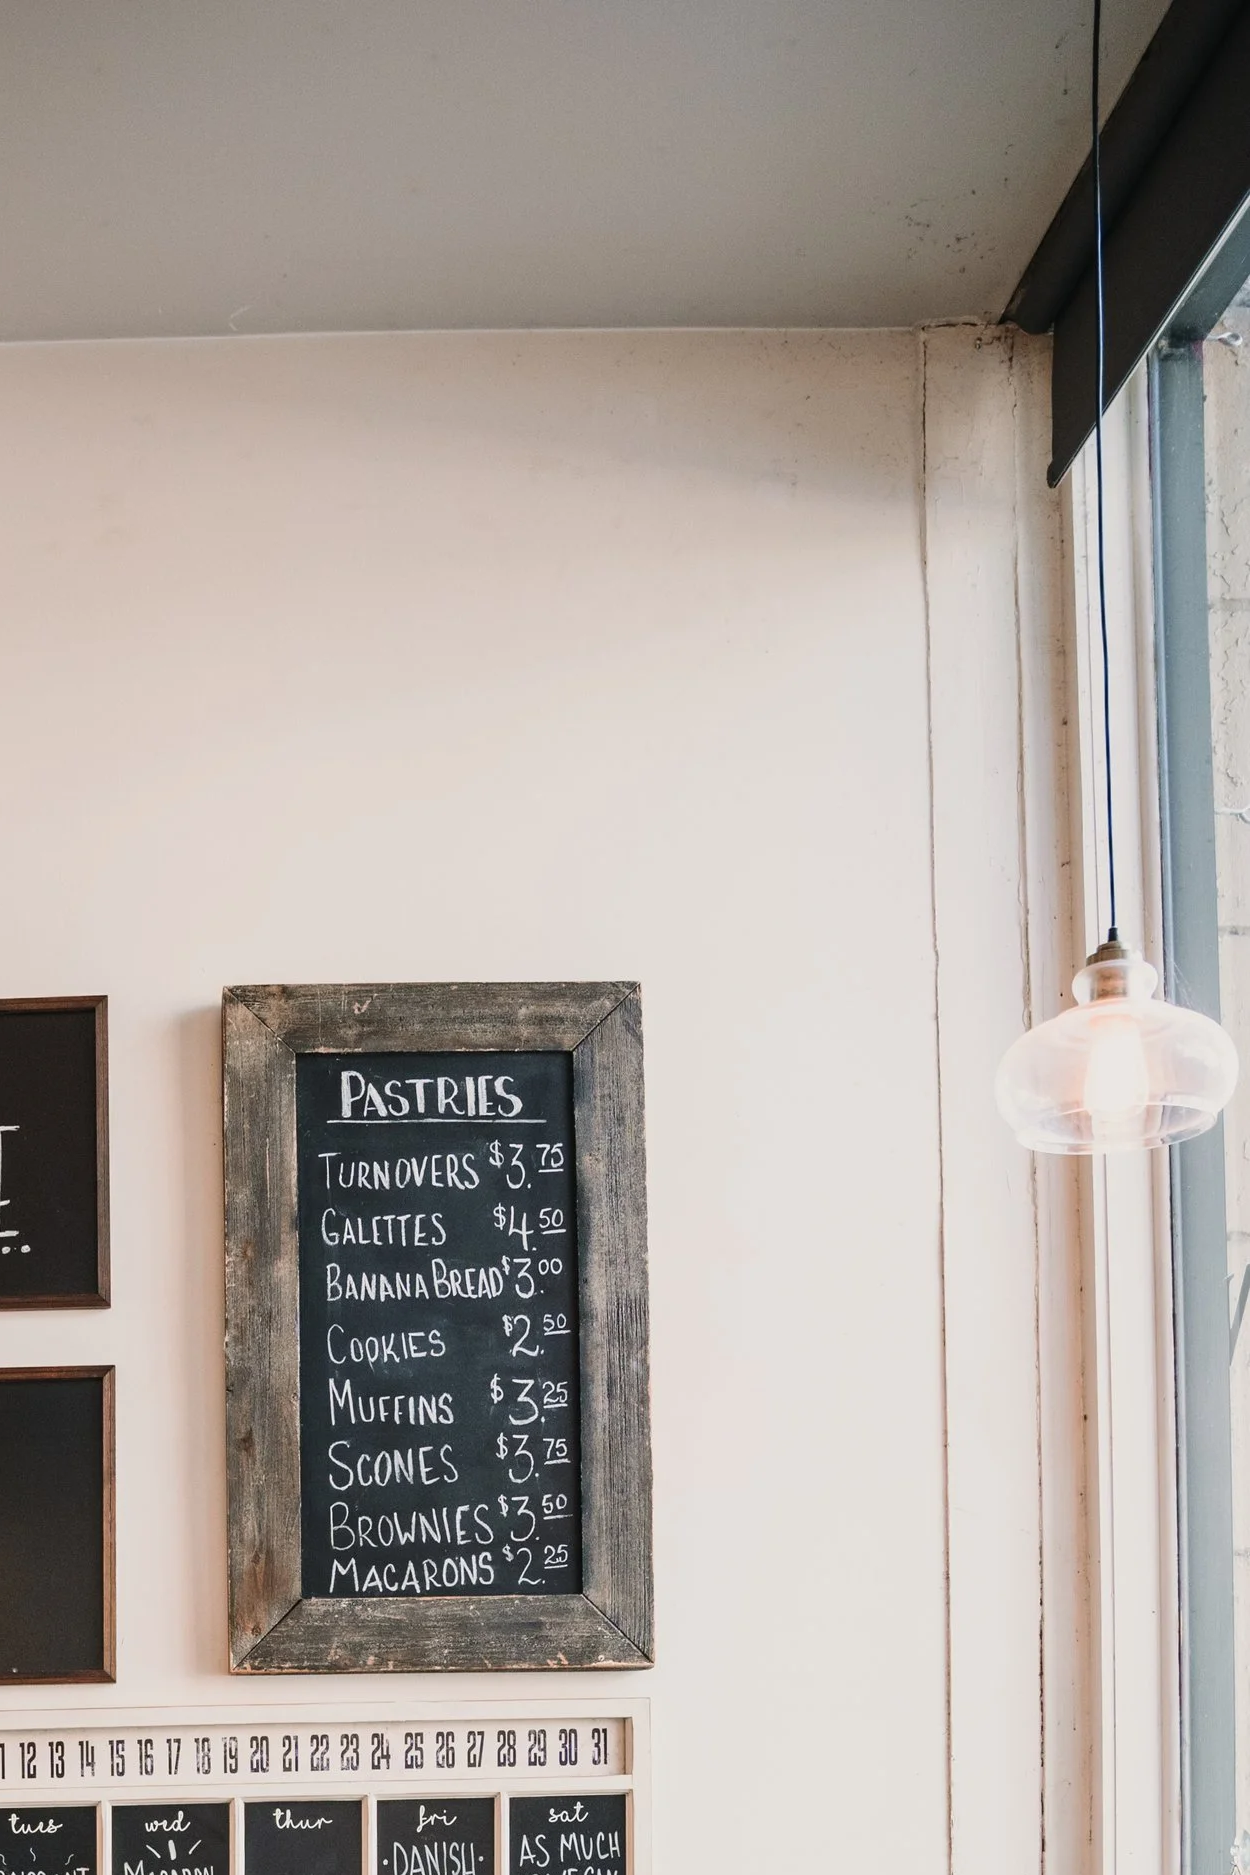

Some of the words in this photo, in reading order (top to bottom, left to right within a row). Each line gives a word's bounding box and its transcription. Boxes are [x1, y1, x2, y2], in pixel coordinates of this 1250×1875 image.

[340, 1070, 524, 1119] PASTRIES
[318, 1151, 481, 1191] TURNOVERS
[320, 1207, 448, 1248] GALETTES
[325, 1262, 430, 1302] BANANA
[431, 1257, 504, 1300] BREAD
[326, 1324, 447, 1366] COOKIES
[328, 1377, 455, 1427] MUFFINS
[328, 1439, 459, 1491] SCONES
[328, 1500, 495, 1551] BROWNIES
[329, 1552, 495, 1594] MACARONS
[19, 1742, 37, 1780] 12
[48, 1741, 65, 1779] 13
[78, 1740, 96, 1777] 14
[108, 1739, 126, 1777] 15
[137, 1738, 154, 1776] 16
[166, 1737, 182, 1775] 17
[194, 1737, 211, 1775] 18
[222, 1736, 239, 1774] 19
[249, 1735, 270, 1774] 20
[281, 1734, 299, 1773] 21
[310, 1734, 330, 1771] 22
[340, 1733, 360, 1771] 23
[370, 1732, 391, 1771] 24
[404, 1732, 425, 1769] 25
[435, 1731, 456, 1769] 26
[467, 1730, 485, 1768] 27
[496, 1729, 517, 1768] 28
[527, 1728, 548, 1767] 29
[558, 1727, 579, 1767] 30
[590, 1726, 609, 1766] 31
[8, 1813, 63, 1836] tues
[145, 1809, 191, 1834] wed
[272, 1808, 333, 1831] thur
[416, 1804, 457, 1833] fri
[548, 1801, 589, 1824] sat
[519, 1833, 550, 1867] AS
[560, 1831, 621, 1862] MUCH
